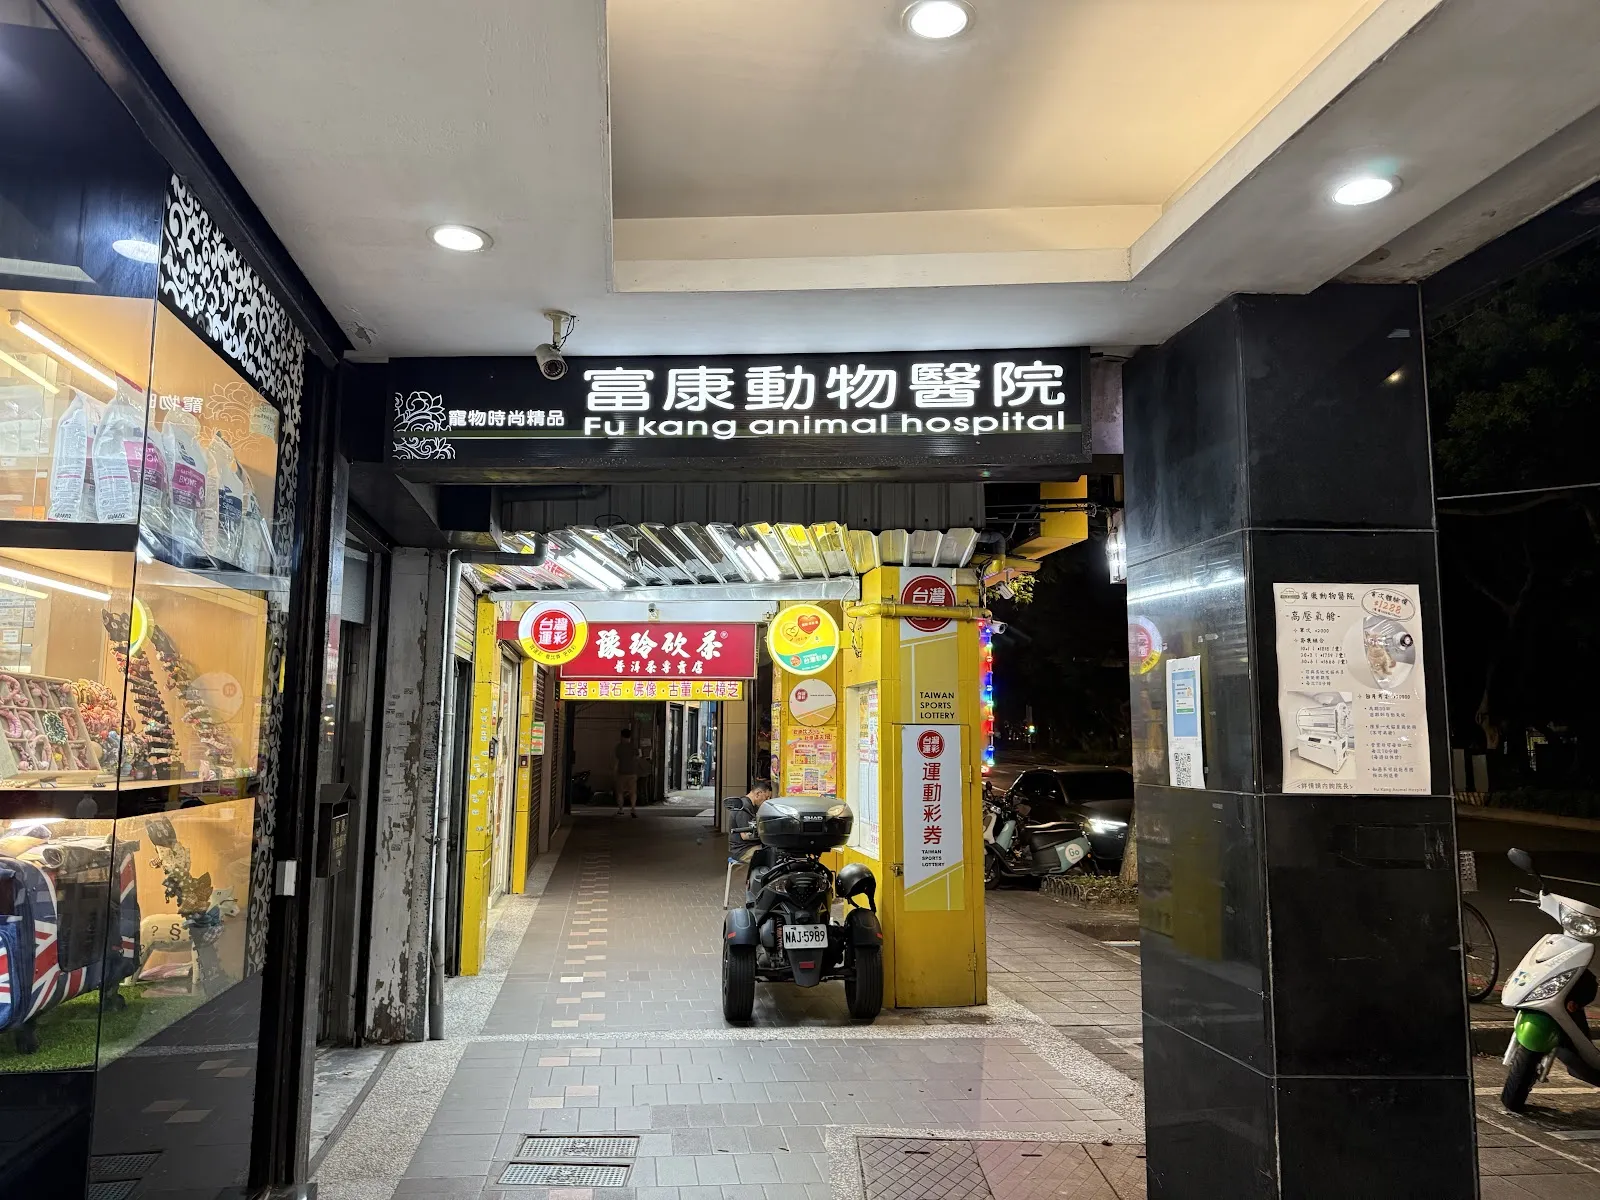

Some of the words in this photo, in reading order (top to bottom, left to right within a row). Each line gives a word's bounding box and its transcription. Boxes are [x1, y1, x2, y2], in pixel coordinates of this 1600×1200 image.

[583, 359, 1066, 413] 富康動物醫院
[448, 409, 565, 429] 寵物時尚精品
[583, 417, 630, 437] Fu
[638, 414, 736, 441] kang
[749, 413, 889, 434] animal
[901, 409, 1066, 438] hospital
[912, 586, 946, 604] 台灣
[539, 617, 569, 631] 台灣
[538, 631, 568, 645] 運彩
[919, 691, 955, 699] TAIWAN
[919, 712, 955, 720] LOTTERY
[922, 762, 942, 845] 運動彩券
